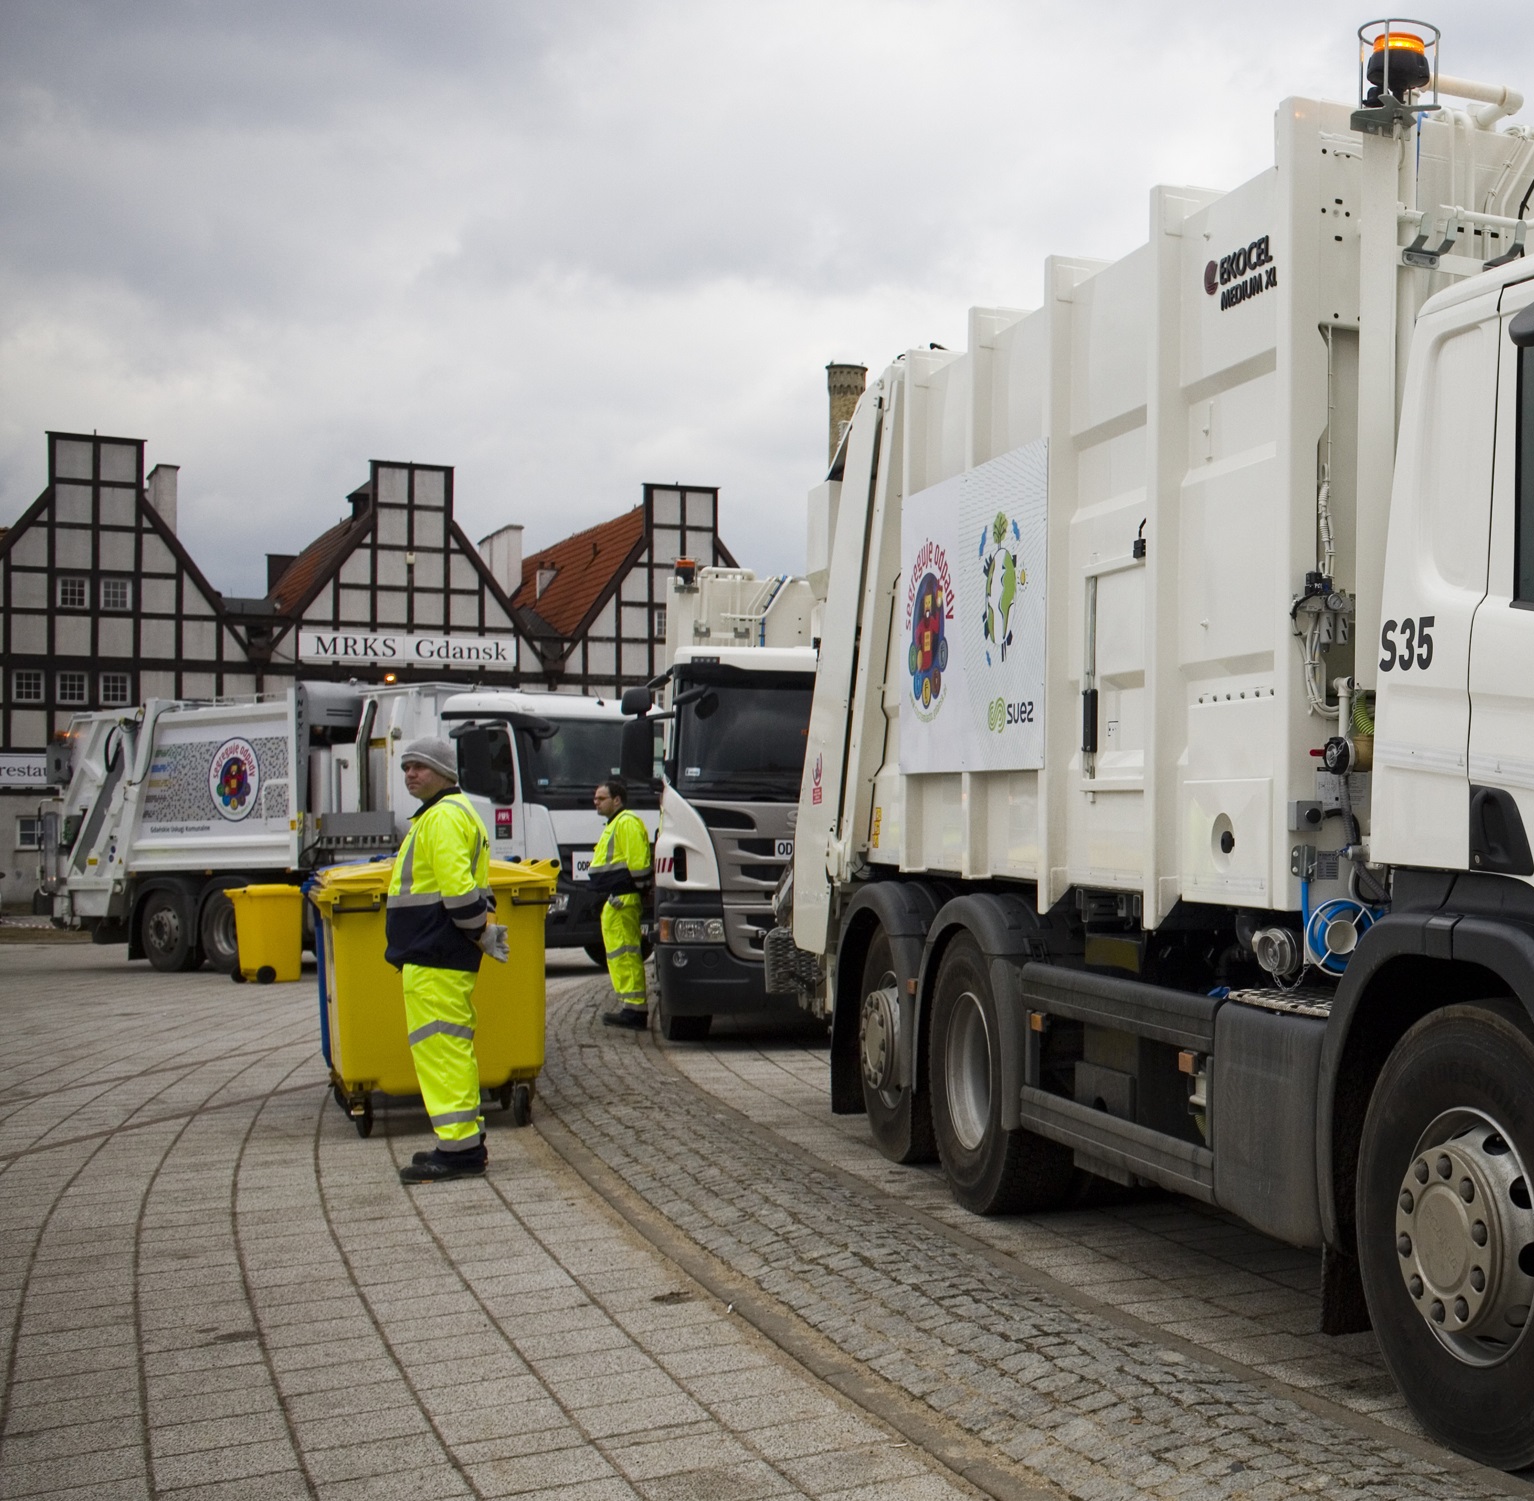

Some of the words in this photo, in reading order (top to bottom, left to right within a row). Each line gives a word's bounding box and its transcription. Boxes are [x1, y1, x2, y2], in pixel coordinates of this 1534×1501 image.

[1219, 235, 1273, 285] EKOCEL
[1221, 273, 1263, 311] MEDIUM
[1265, 266, 1277, 290] XL
[934, 544, 955, 619] odpady
[314, 636, 397, 658] MRKS
[415, 639, 508, 661] Gdansk
[1379, 615, 1435, 672] S35
[1006, 701, 1034, 724] suez
